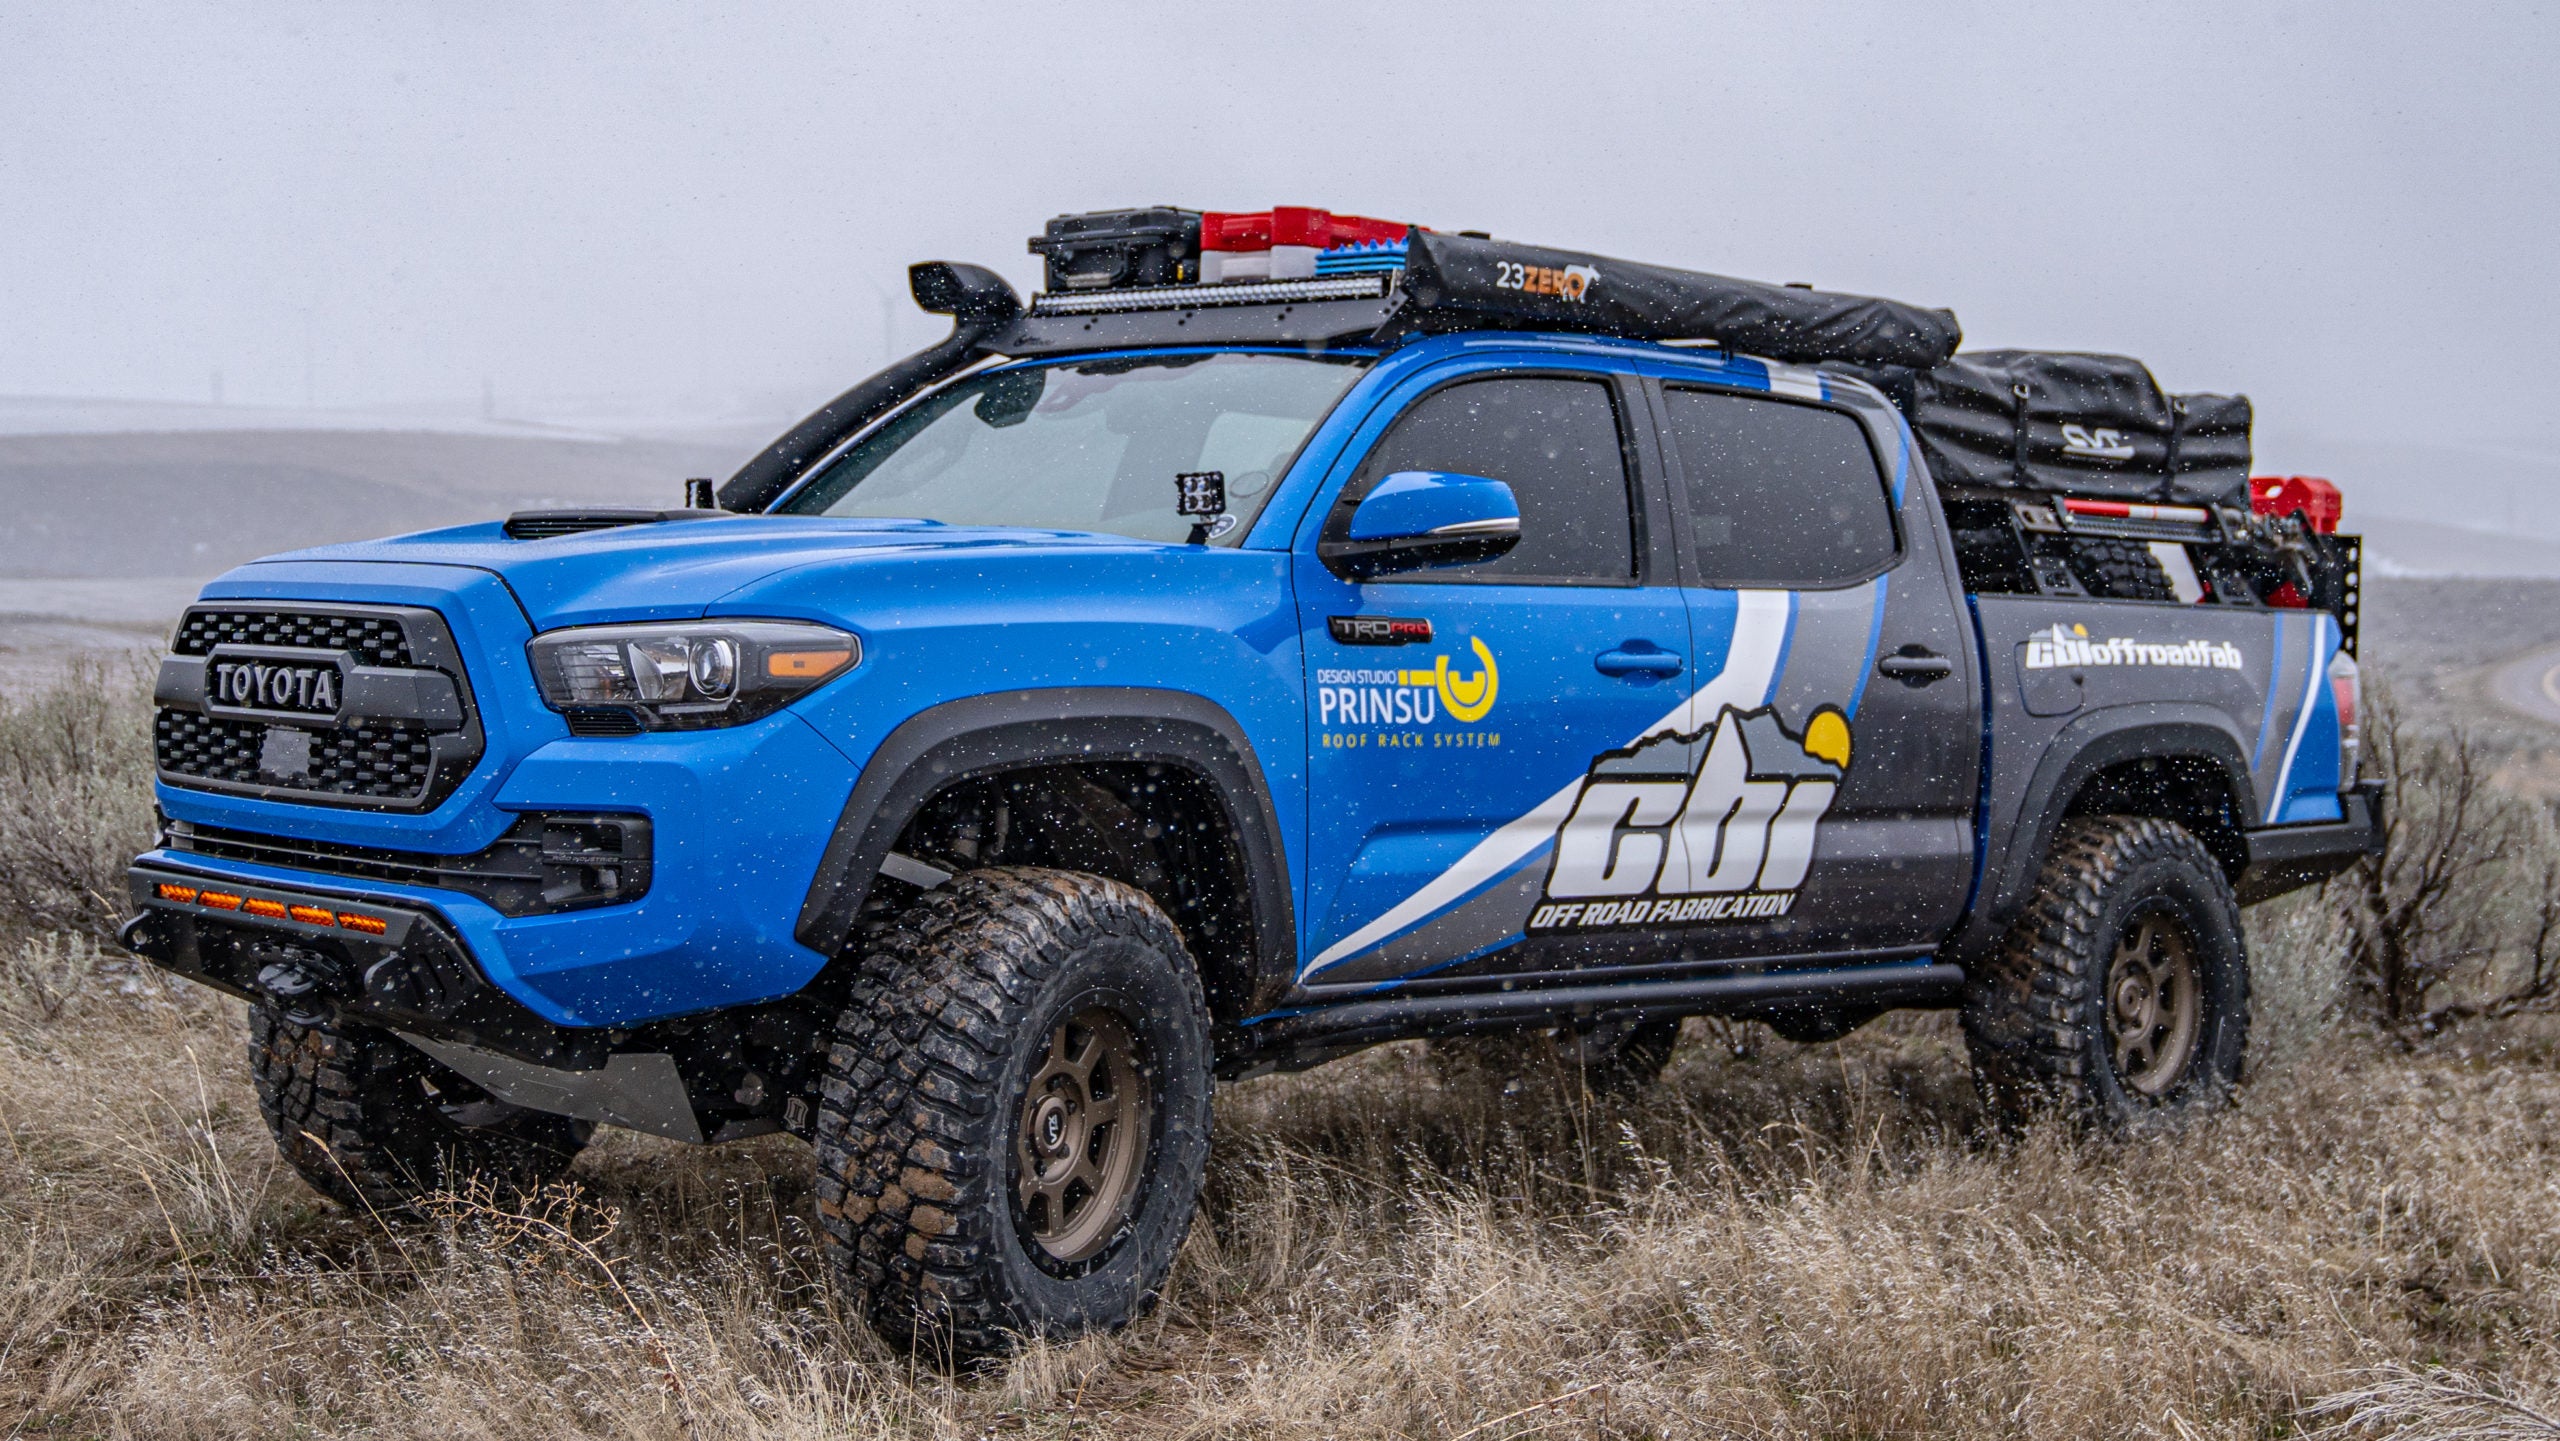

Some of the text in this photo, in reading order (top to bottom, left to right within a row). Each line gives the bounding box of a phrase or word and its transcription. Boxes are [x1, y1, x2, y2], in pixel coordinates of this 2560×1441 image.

[1496, 261, 1585, 298] 23ZERO
[1336, 619, 1429, 638] TRD PRO
[216, 663, 333, 708] TOYOTA
[1317, 669, 1397, 684] DESIGN STUDIO
[1319, 687, 1440, 725] PRINSU
[1322, 732, 1501, 748] ROOF RACK SYSTEM
[1530, 893, 1797, 928] OFF ROAD FABRICATION
